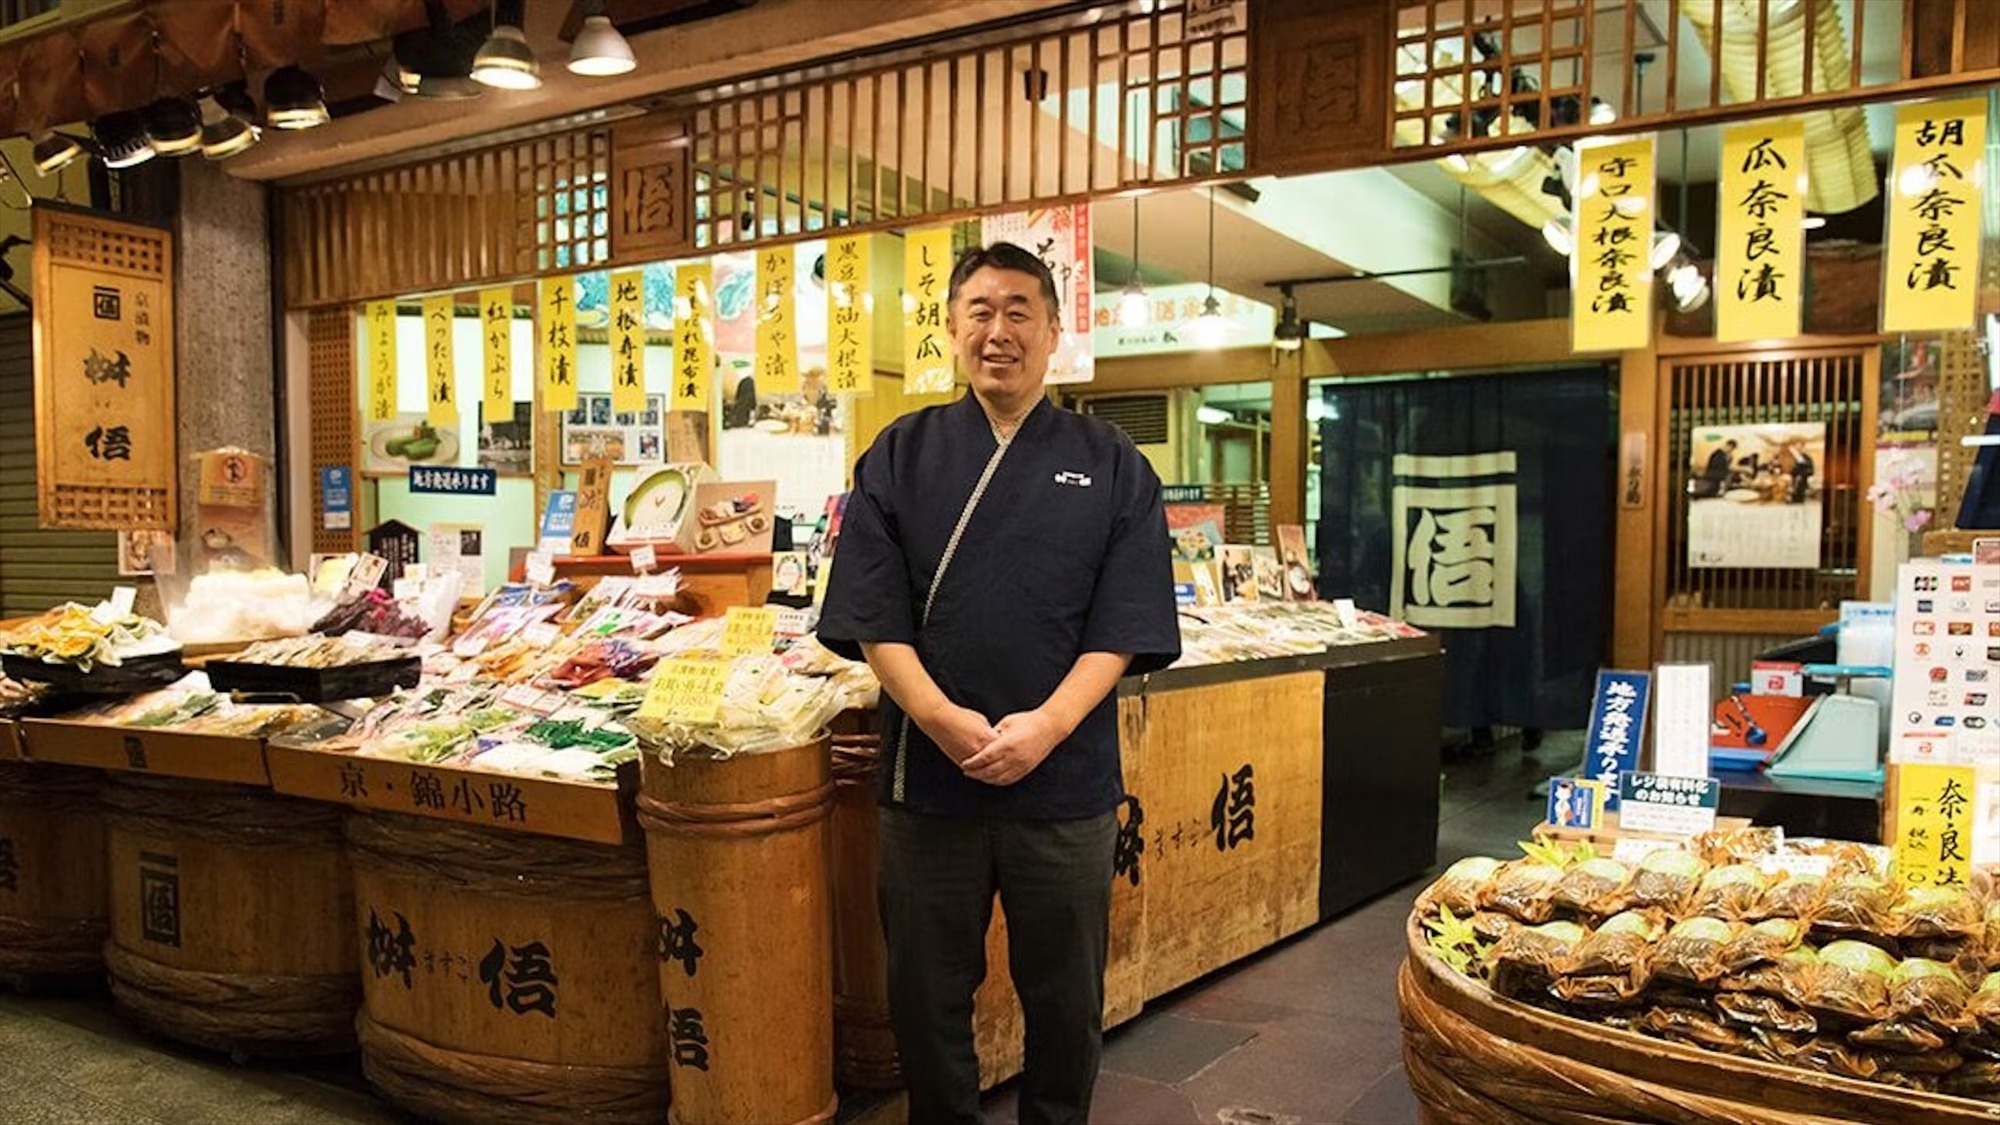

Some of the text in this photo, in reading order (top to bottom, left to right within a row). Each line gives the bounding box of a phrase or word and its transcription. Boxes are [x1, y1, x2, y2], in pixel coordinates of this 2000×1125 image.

[1592, 157, 1638, 313] 守口大根奈良漬
[1737, 138, 1789, 302] 瓜奈良漬
[1907, 119, 1976, 290] 胡瓜奈良漬
[431, 306, 451, 403] べったら漬
[486, 301, 507, 399] 紅かぶら
[548, 286, 571, 386] 千枚漬
[765, 253, 787, 377] かぼちゃ漬
[917, 245, 942, 360] しそ胡瓜
[338, 763, 527, 822] 京・錦小路
[1634, 788, 1702, 805] のお知らせ
